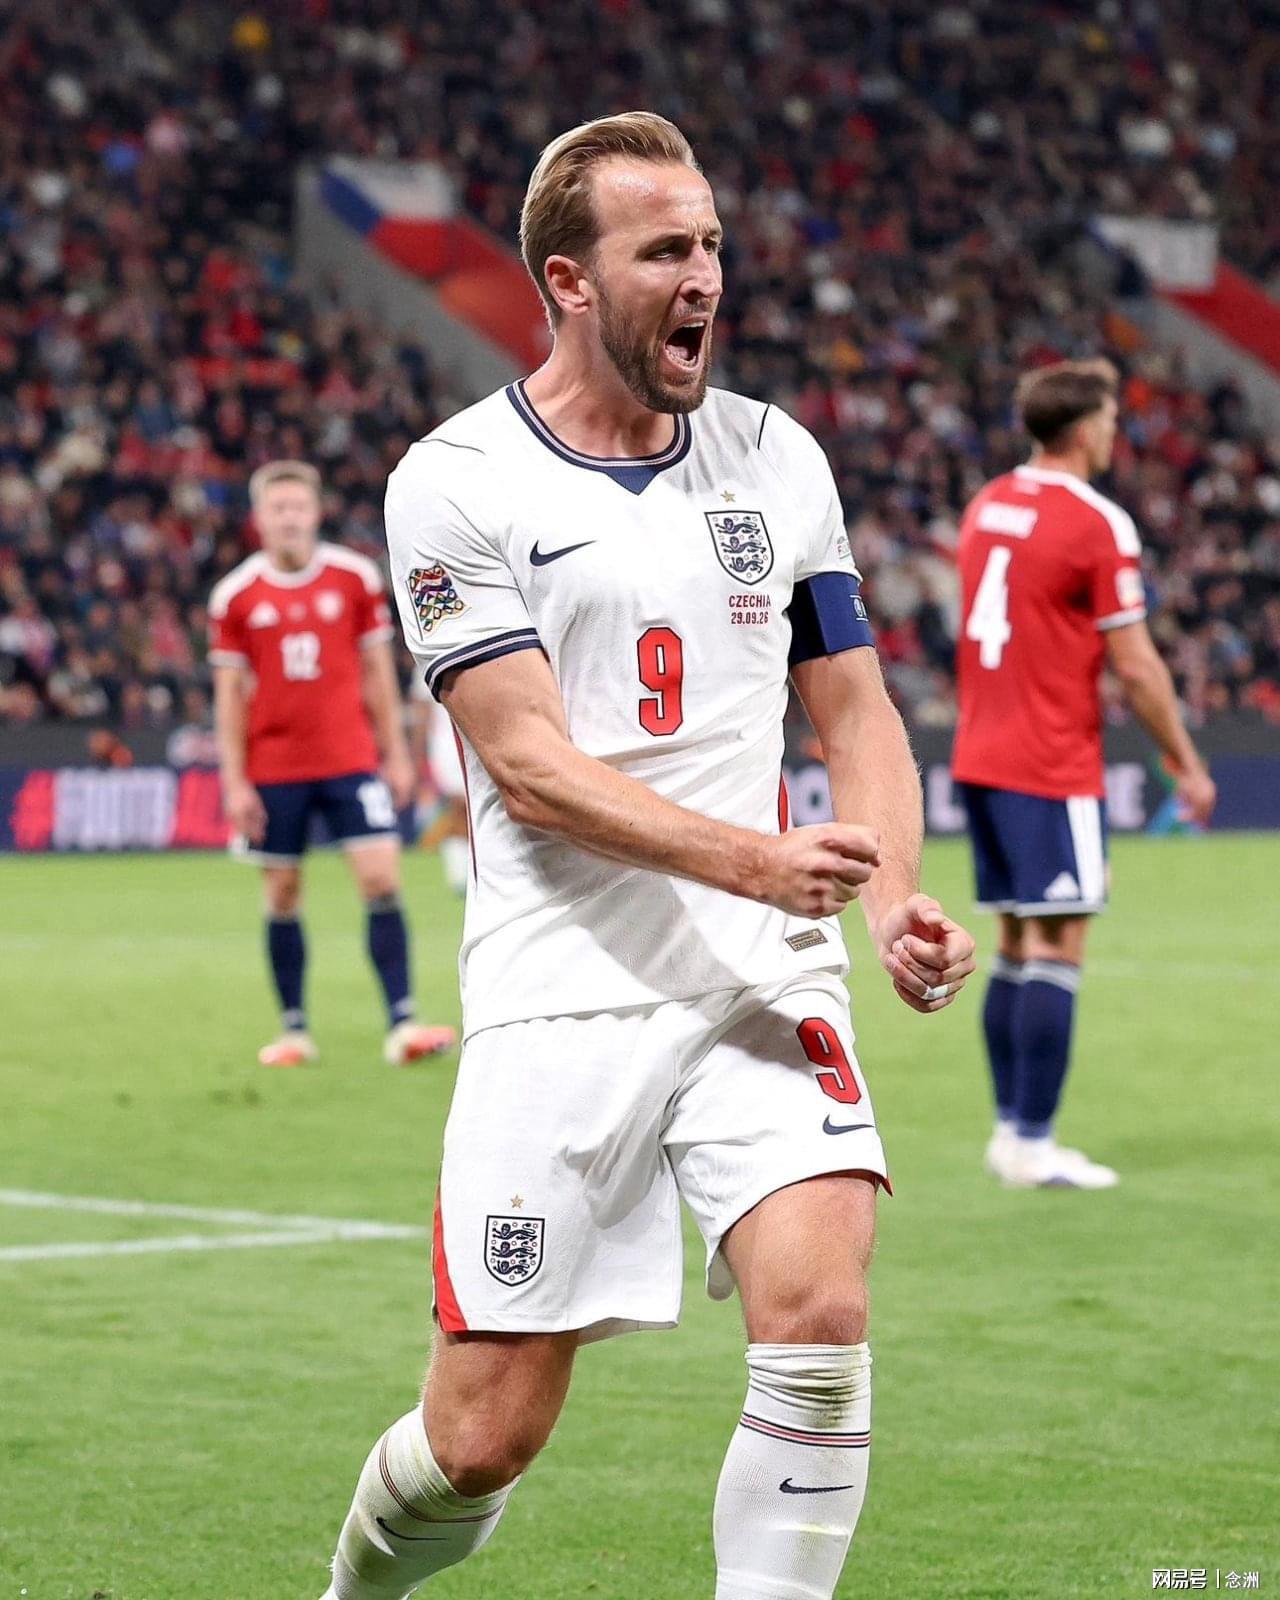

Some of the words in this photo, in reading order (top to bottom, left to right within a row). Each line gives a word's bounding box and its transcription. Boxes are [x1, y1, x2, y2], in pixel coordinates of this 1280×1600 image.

[728, 594, 771, 608] CZECHIA
[731, 611, 769, 624] 29.09.26
[966, 545, 1012, 670] 4
[280, 631, 323, 681] 12
[637, 627, 683, 736] 9
[796, 1017, 861, 1104] 9
